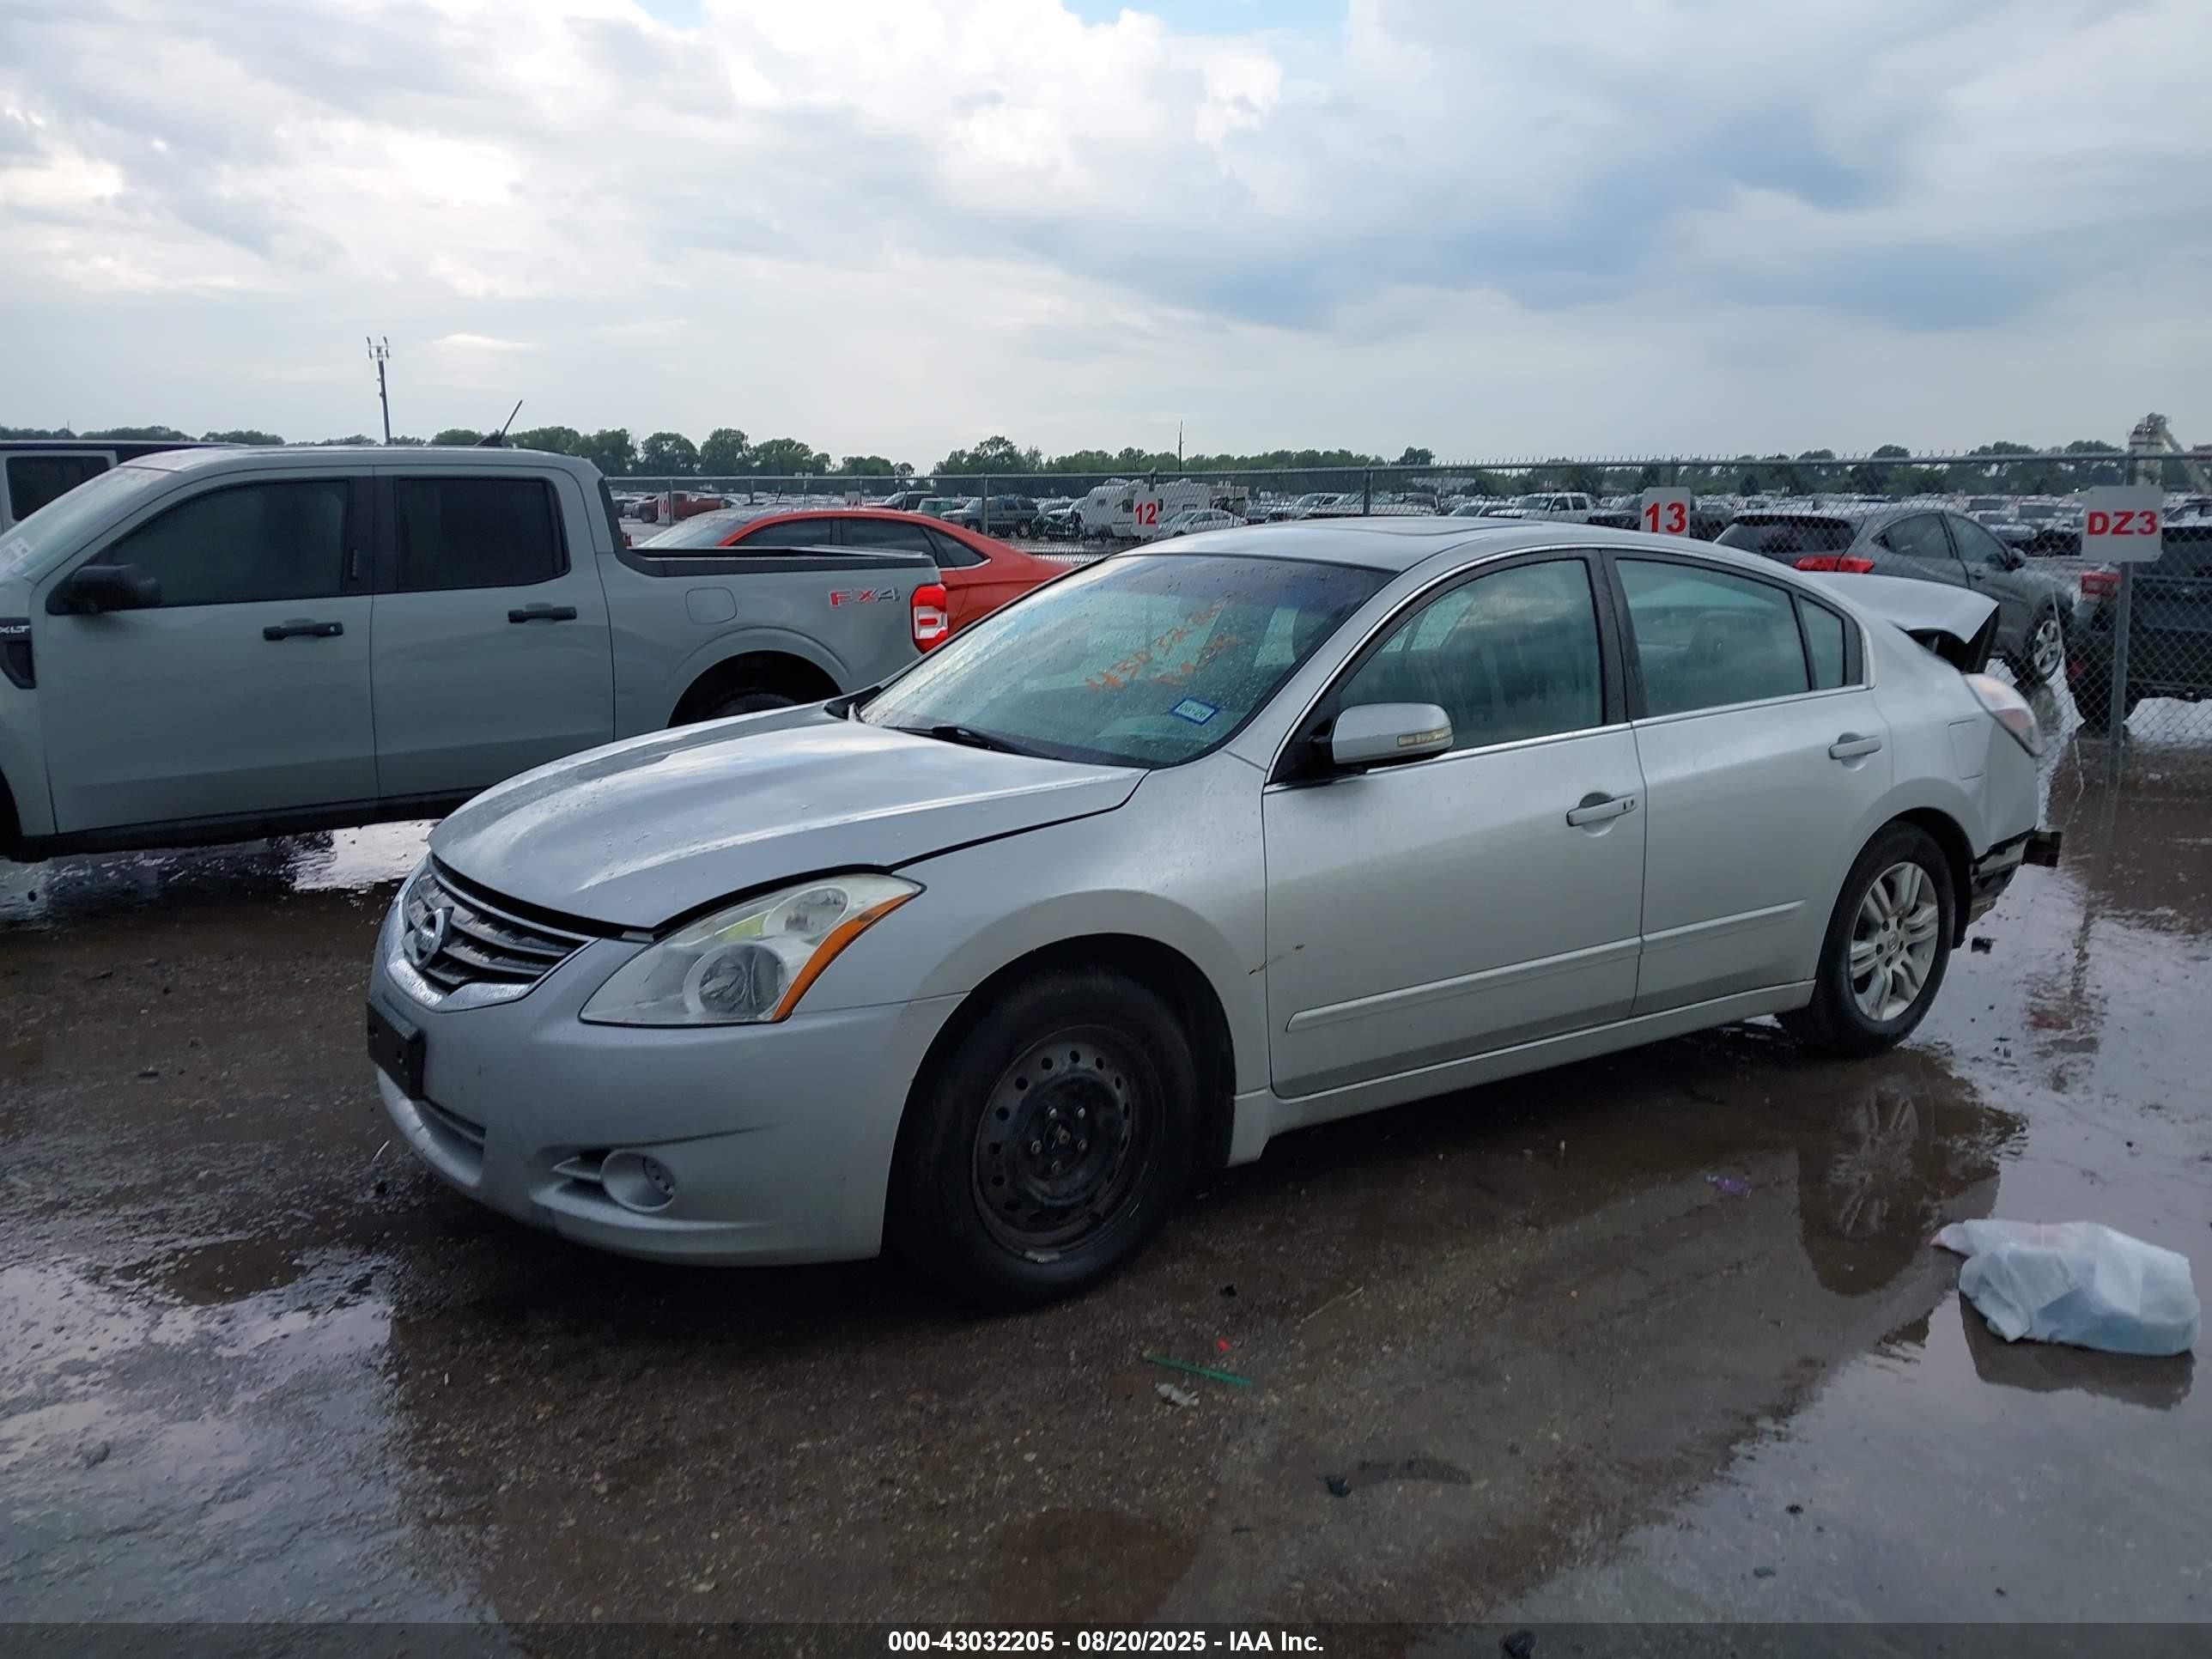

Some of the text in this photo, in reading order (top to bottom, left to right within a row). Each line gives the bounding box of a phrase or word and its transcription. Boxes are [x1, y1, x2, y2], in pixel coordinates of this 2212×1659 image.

[1135, 502, 1157, 526] 12
[1646, 501, 1687, 534] 13
[2087, 511, 2157, 536] DZ3
[830, 587, 901, 606] FX4
